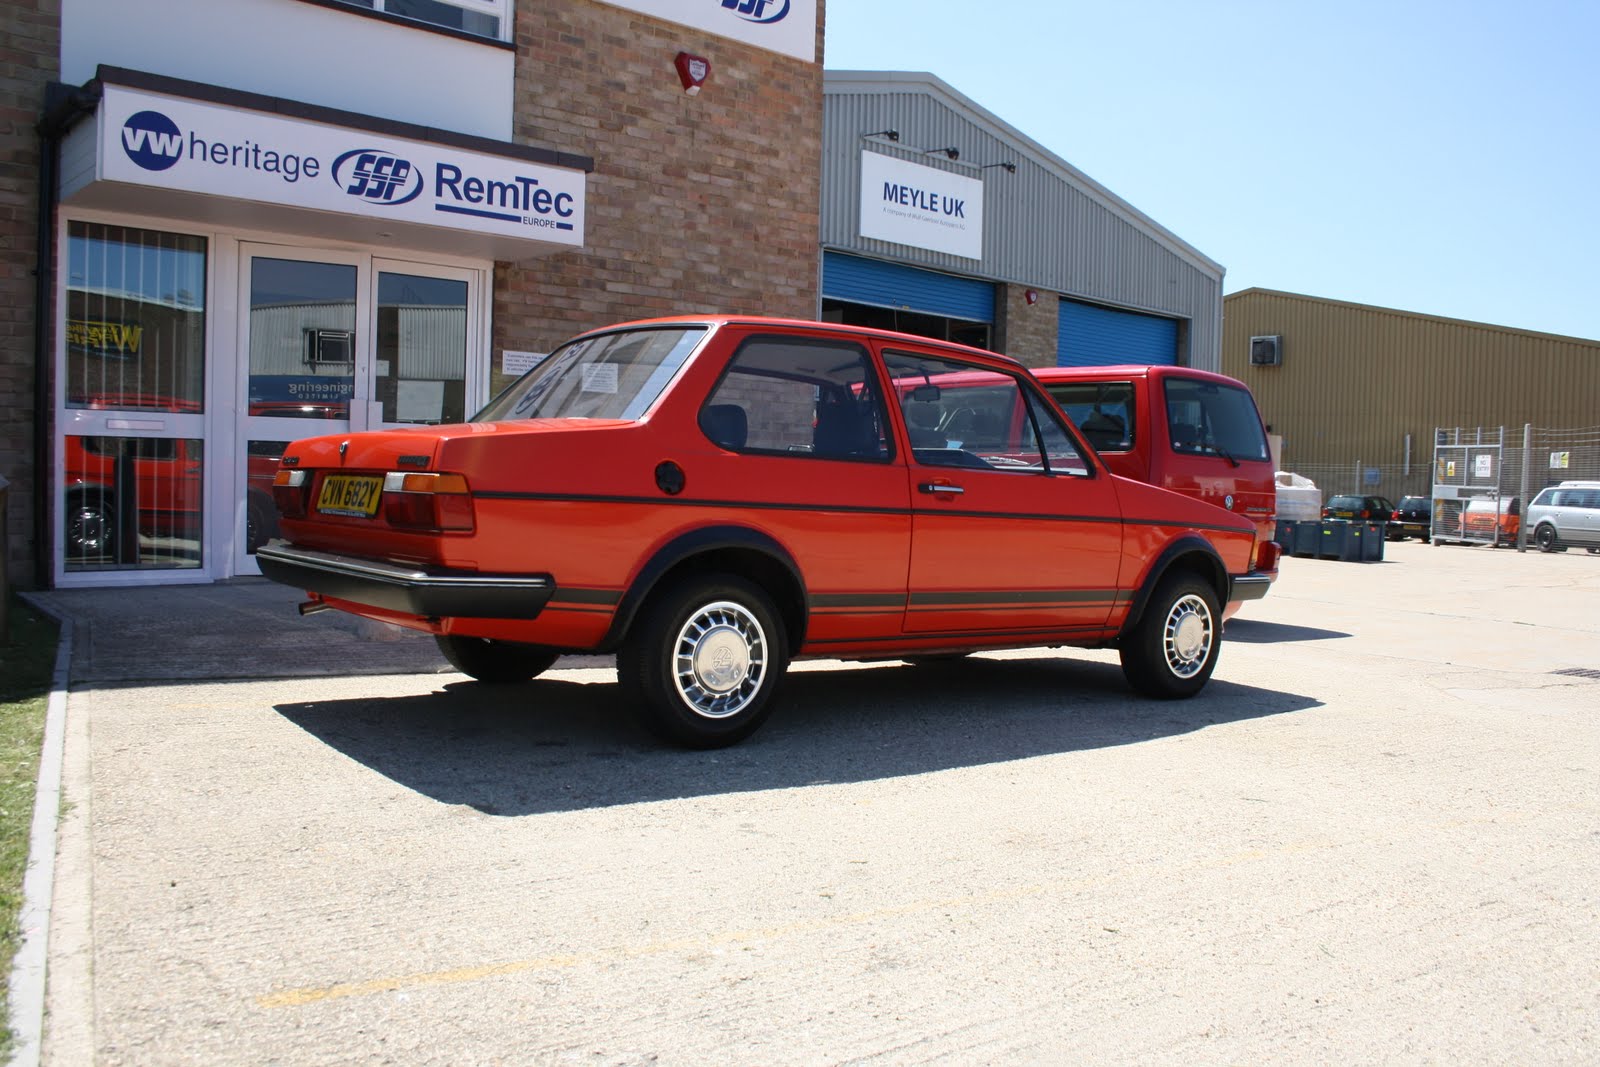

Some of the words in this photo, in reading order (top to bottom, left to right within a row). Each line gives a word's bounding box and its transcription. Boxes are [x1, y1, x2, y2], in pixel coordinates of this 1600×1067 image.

[189, 131, 320, 183] heritage
[346, 153, 411, 200] SSP
[435, 162, 574, 218] RemTec
[883, 181, 938, 213] MEYLE
[942, 196, 965, 219] UK
[887, 209, 907, 218] company
[522, 216, 556, 229] EUROPE
[322, 479, 346, 506] CVN
[343, 480, 379, 509] 682Y
